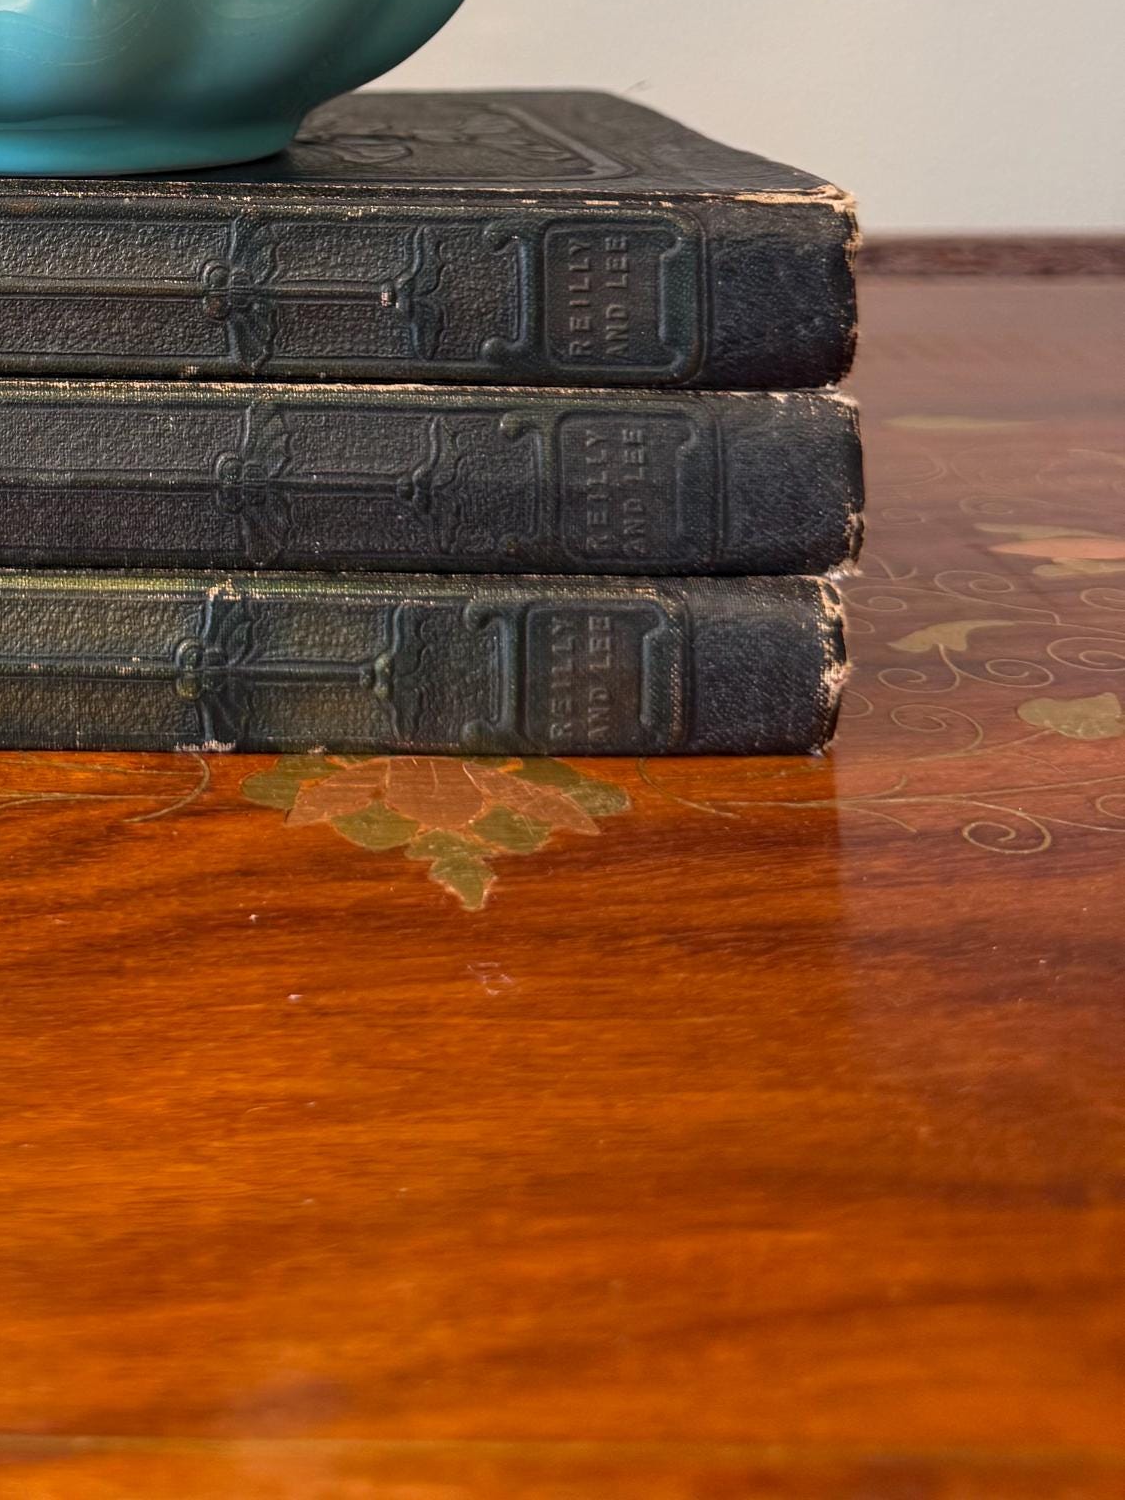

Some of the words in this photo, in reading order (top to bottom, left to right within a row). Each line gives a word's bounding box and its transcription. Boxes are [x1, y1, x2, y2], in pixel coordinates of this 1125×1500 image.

[606, 236, 628, 288] LEE
[568, 238, 591, 356] REILLY
[622, 429, 645, 480] LEE
[587, 430, 610, 551] REILLY
[623, 499, 646, 553] AND
[588, 616, 611, 670] LEE
[550, 616, 573, 740] REILLY
[587, 687, 611, 741] AND
